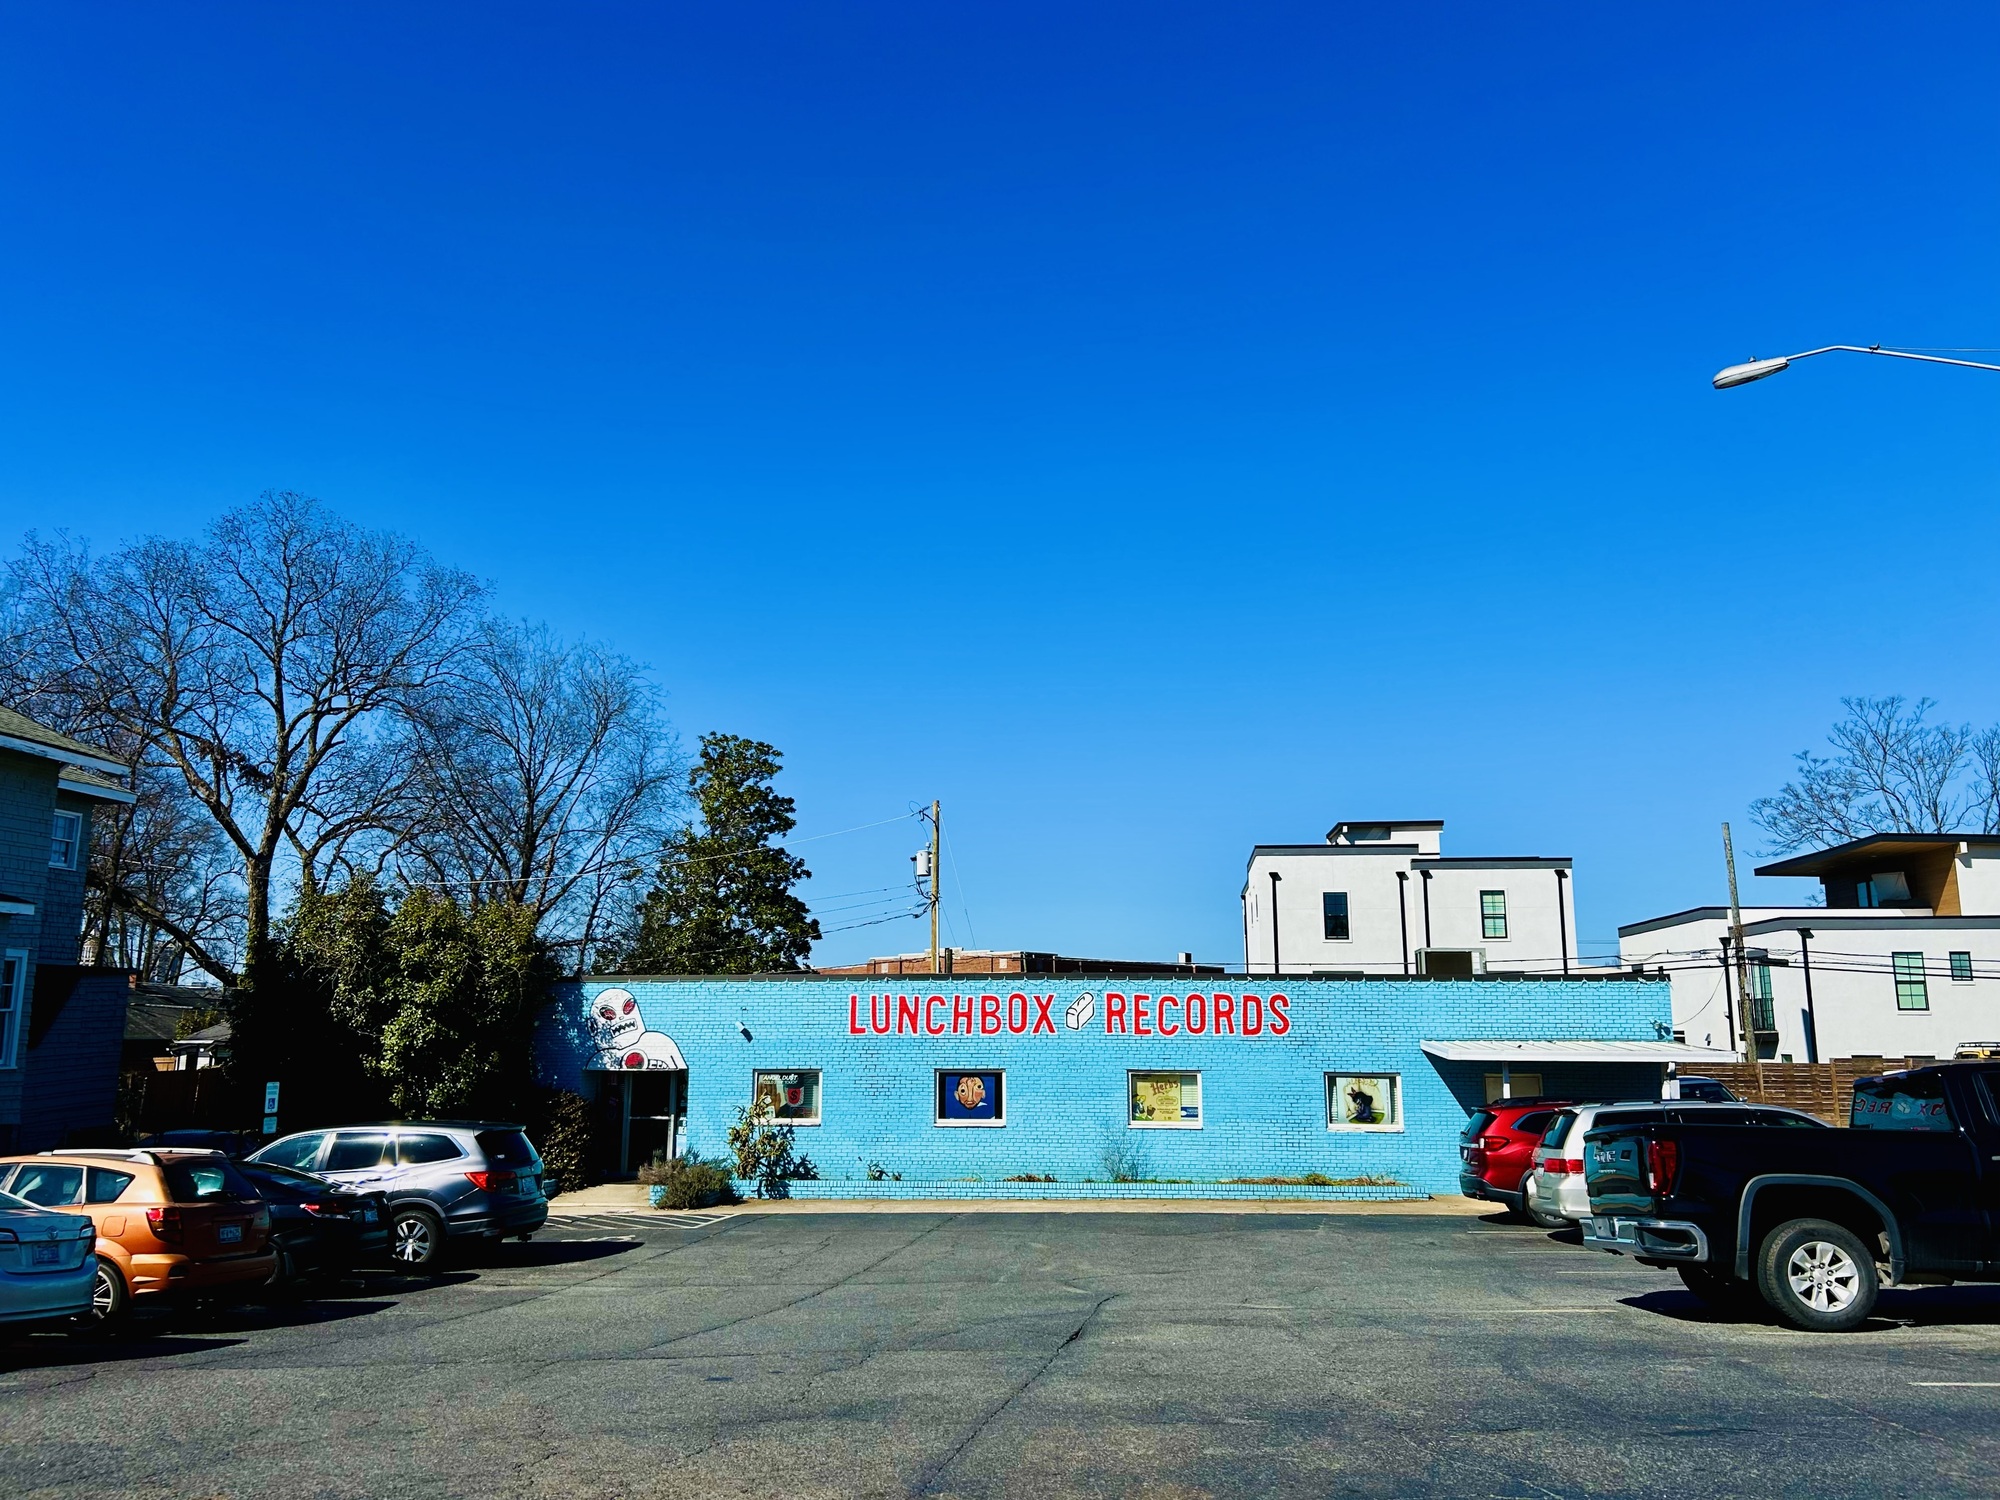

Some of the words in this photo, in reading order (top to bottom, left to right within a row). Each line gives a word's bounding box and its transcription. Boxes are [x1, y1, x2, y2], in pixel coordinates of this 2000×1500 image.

[848, 993, 1057, 1035] LUNCHBOX
[1105, 993, 1291, 1036] RECORDS
[1150, 1080, 1179, 1096] Herbs
